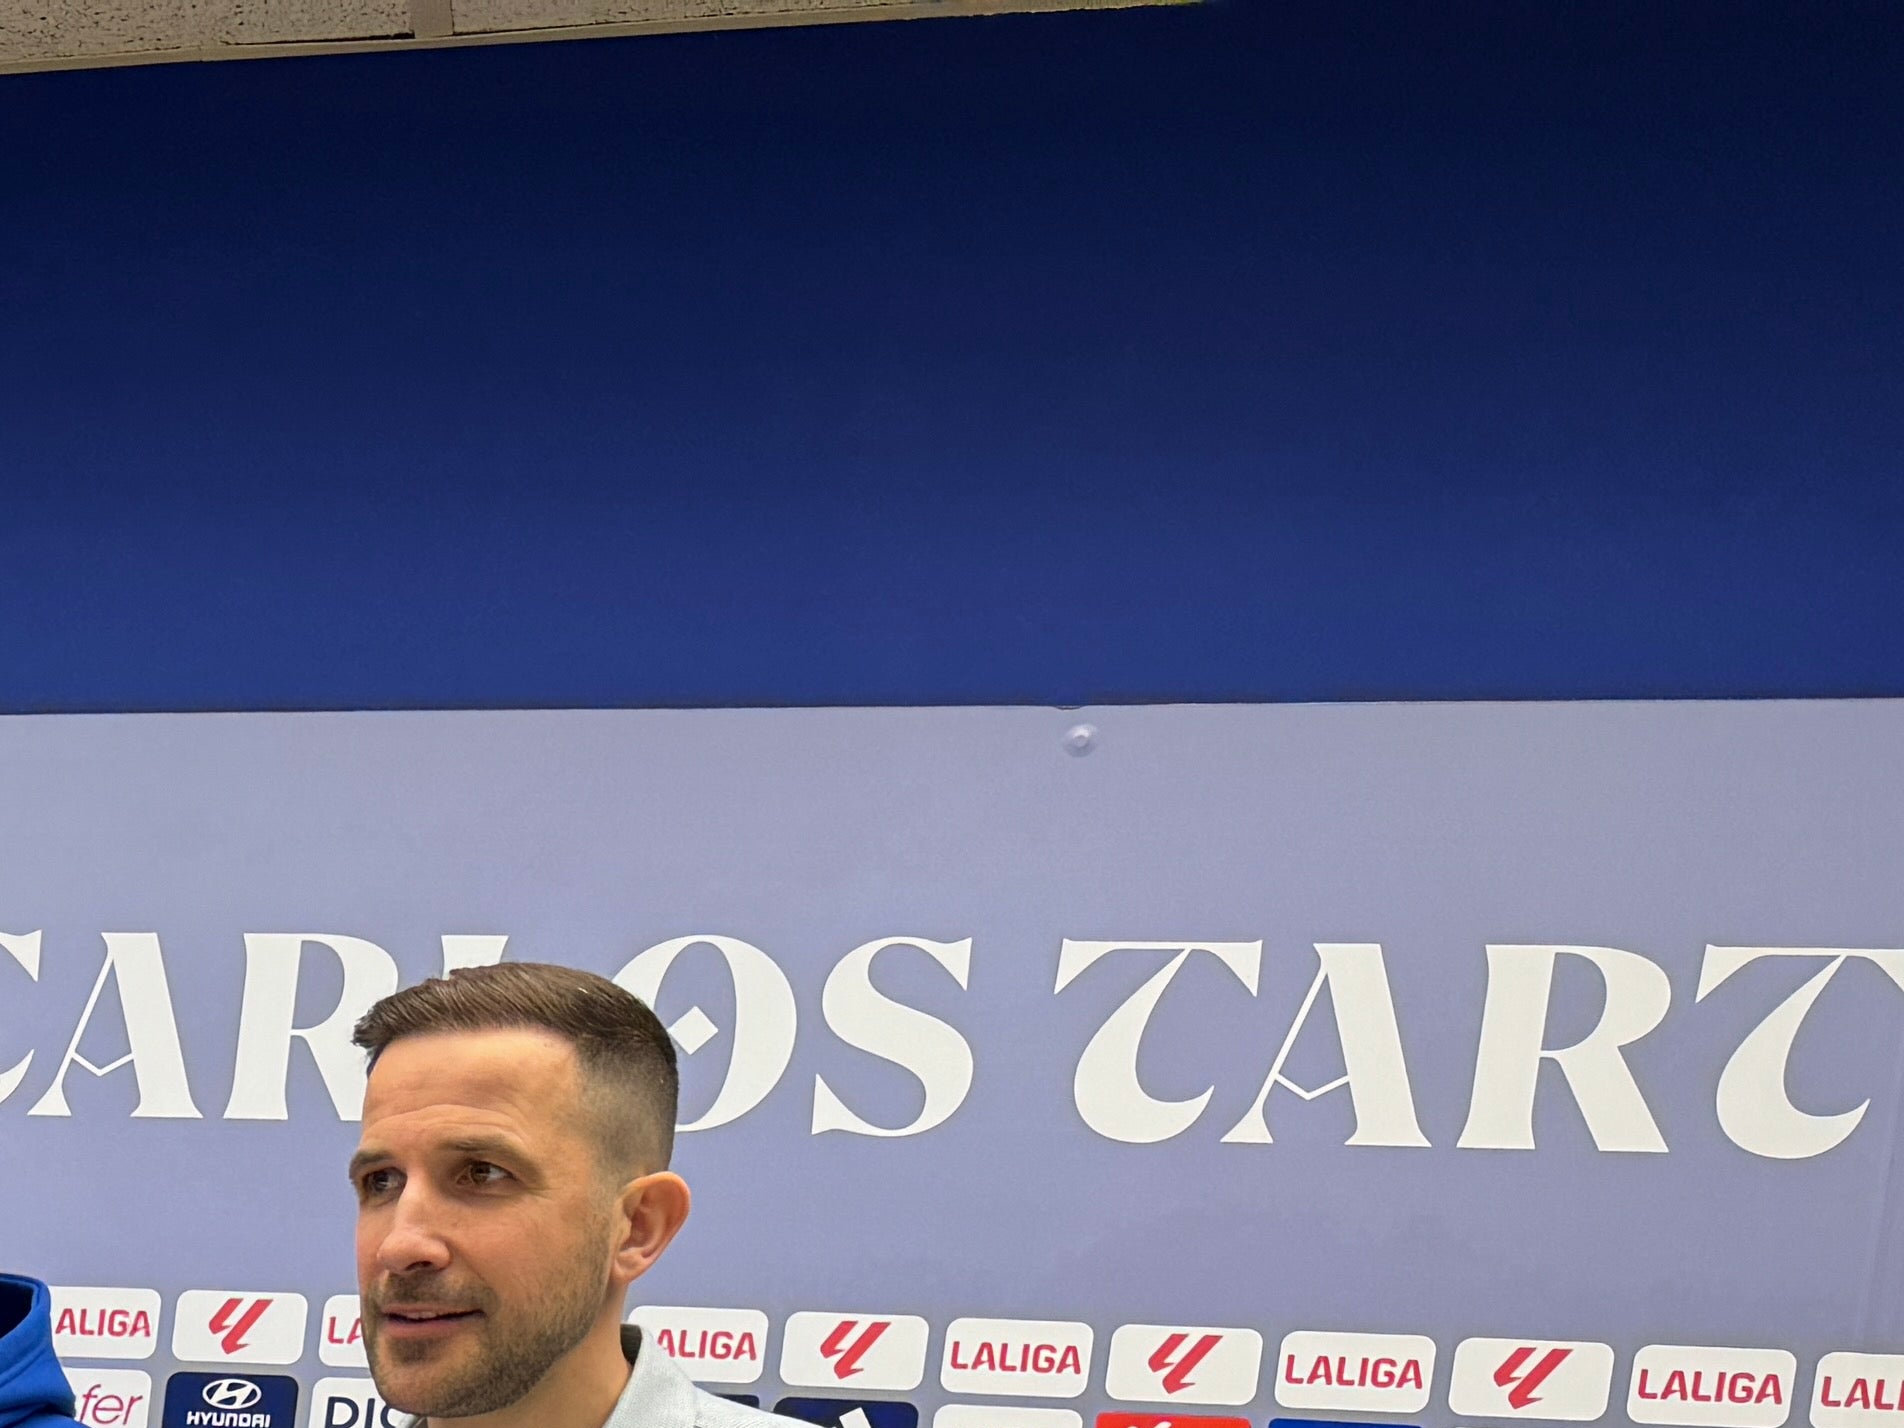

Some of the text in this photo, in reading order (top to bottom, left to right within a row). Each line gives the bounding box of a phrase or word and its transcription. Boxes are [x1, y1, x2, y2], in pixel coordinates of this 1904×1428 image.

[951, 1341, 1081, 1374] LALIGA
[1285, 1354, 1422, 1389] LALIGA
[1634, 1364, 1782, 1404] LALIGA
